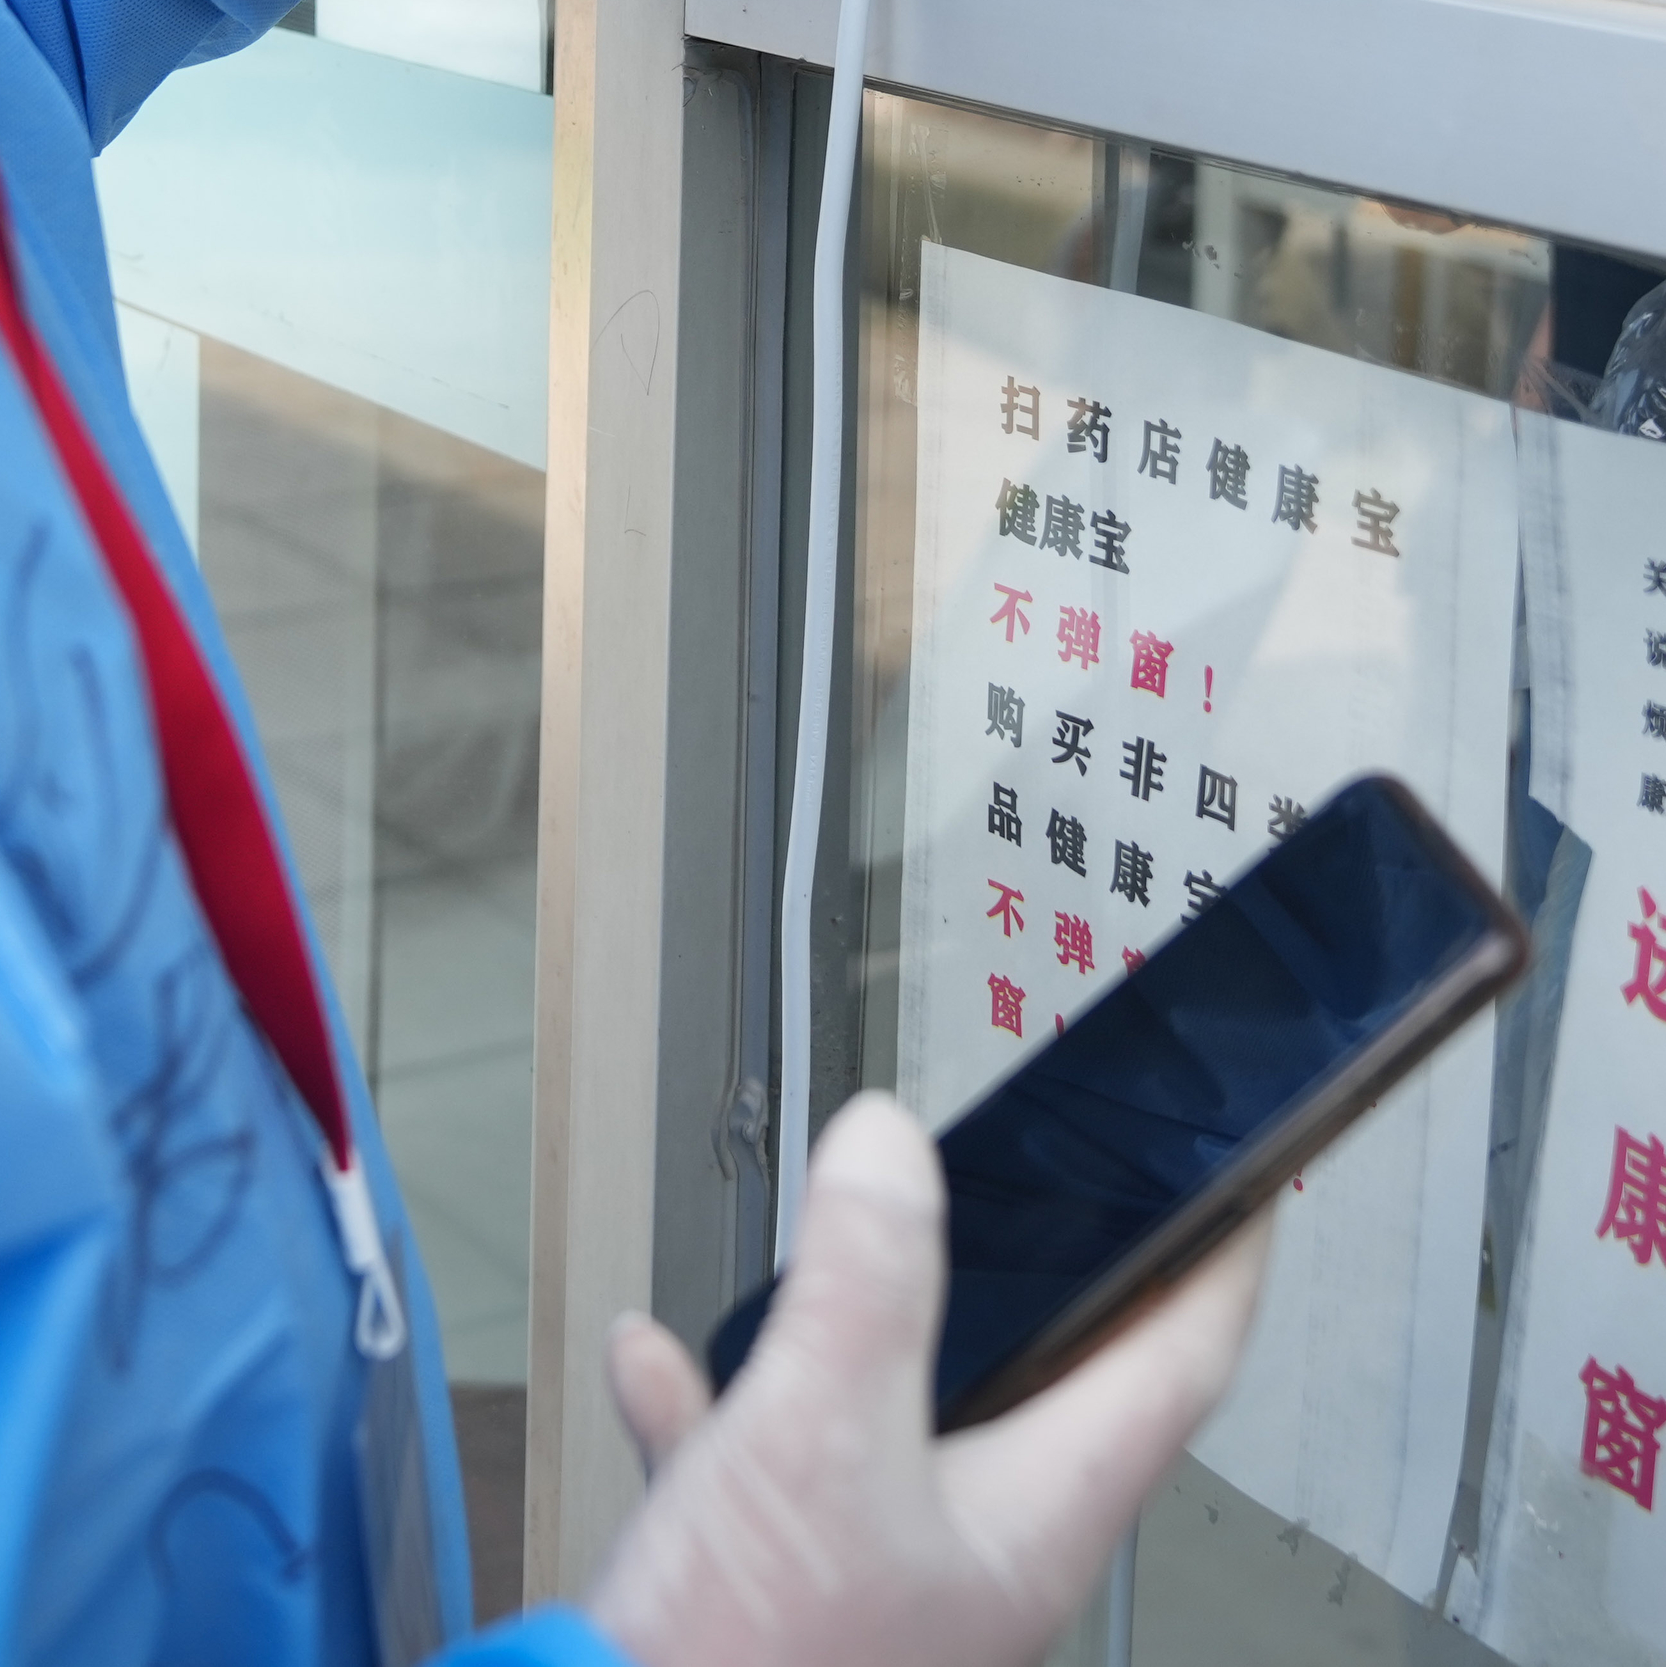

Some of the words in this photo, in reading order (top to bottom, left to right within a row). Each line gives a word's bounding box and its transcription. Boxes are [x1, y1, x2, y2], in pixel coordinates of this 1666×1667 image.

[994, 477, 1132, 575] 健康宝
[999, 374, 1401, 558] 扫药店健康宝
[989, 582, 1214, 714] 不弹窗!
[987, 781, 1230, 926] 品健康宝
[986, 878, 1147, 976] 不弹
